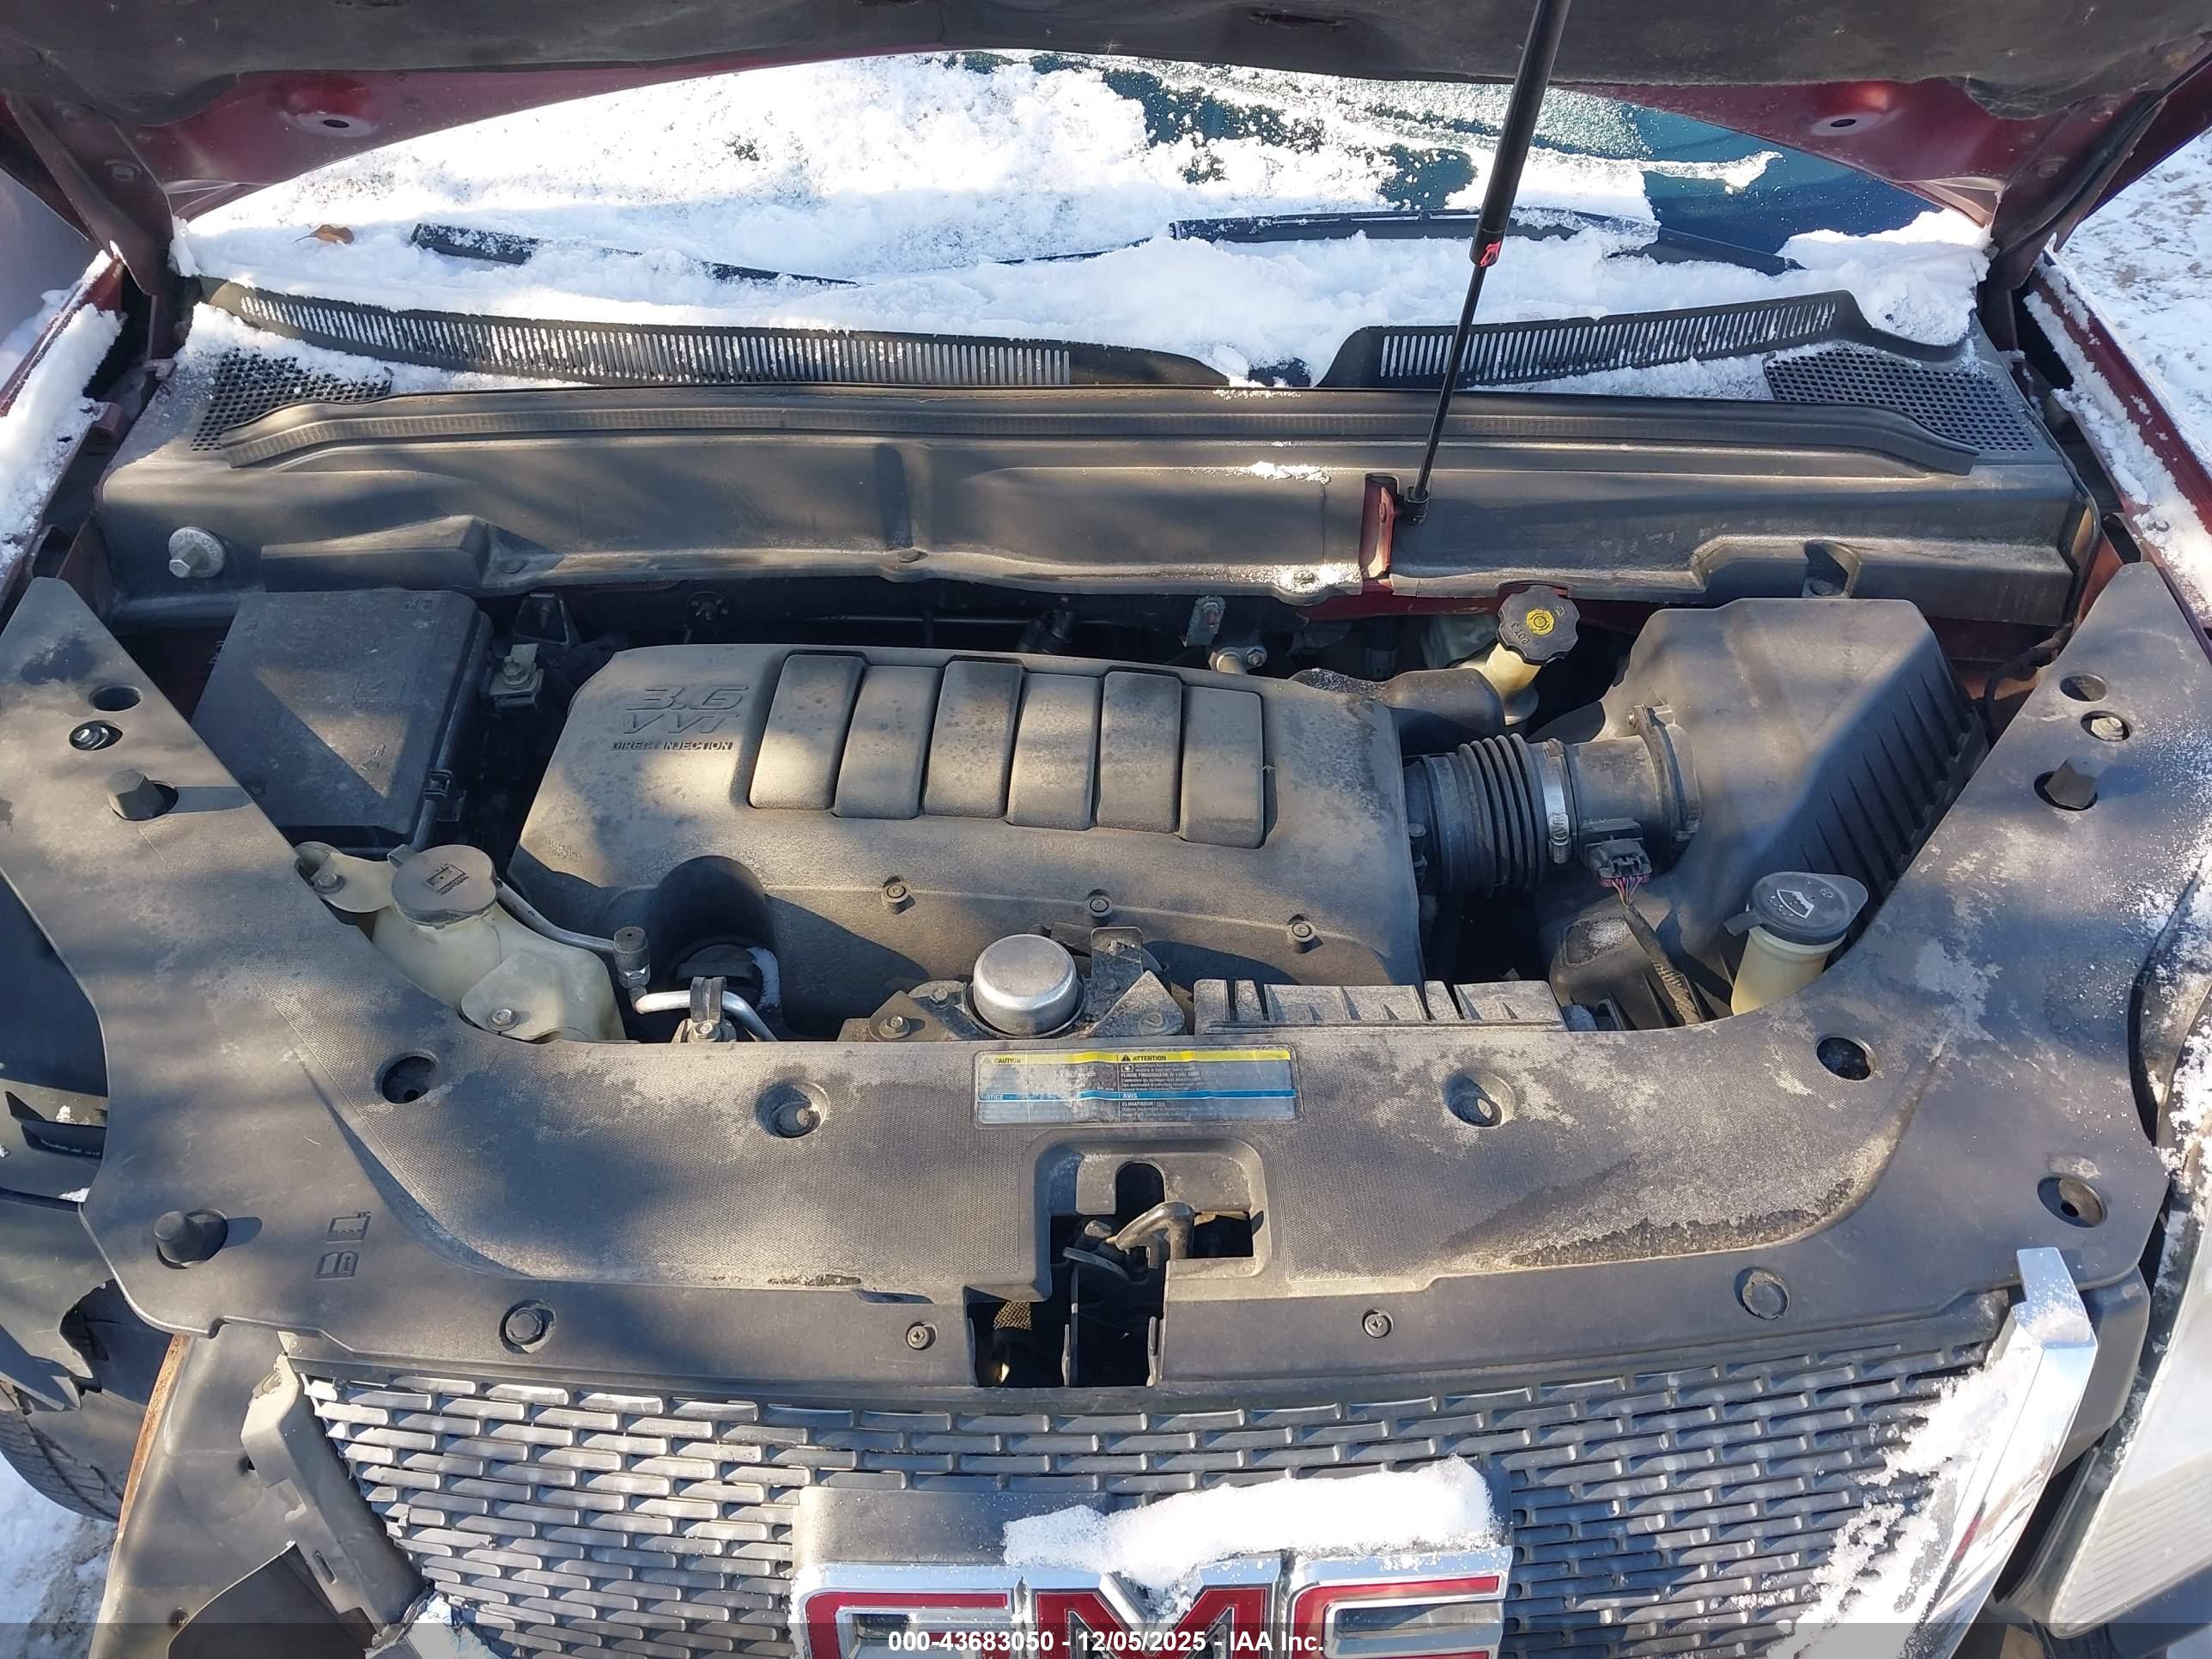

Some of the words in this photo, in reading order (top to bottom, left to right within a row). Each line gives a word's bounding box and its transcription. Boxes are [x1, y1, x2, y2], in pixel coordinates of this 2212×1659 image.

[626, 685, 749, 711] 3.6
[623, 713, 740, 734] VVT
[611, 741, 661, 751] DIRECT
[663, 741, 734, 750] INJECTION
